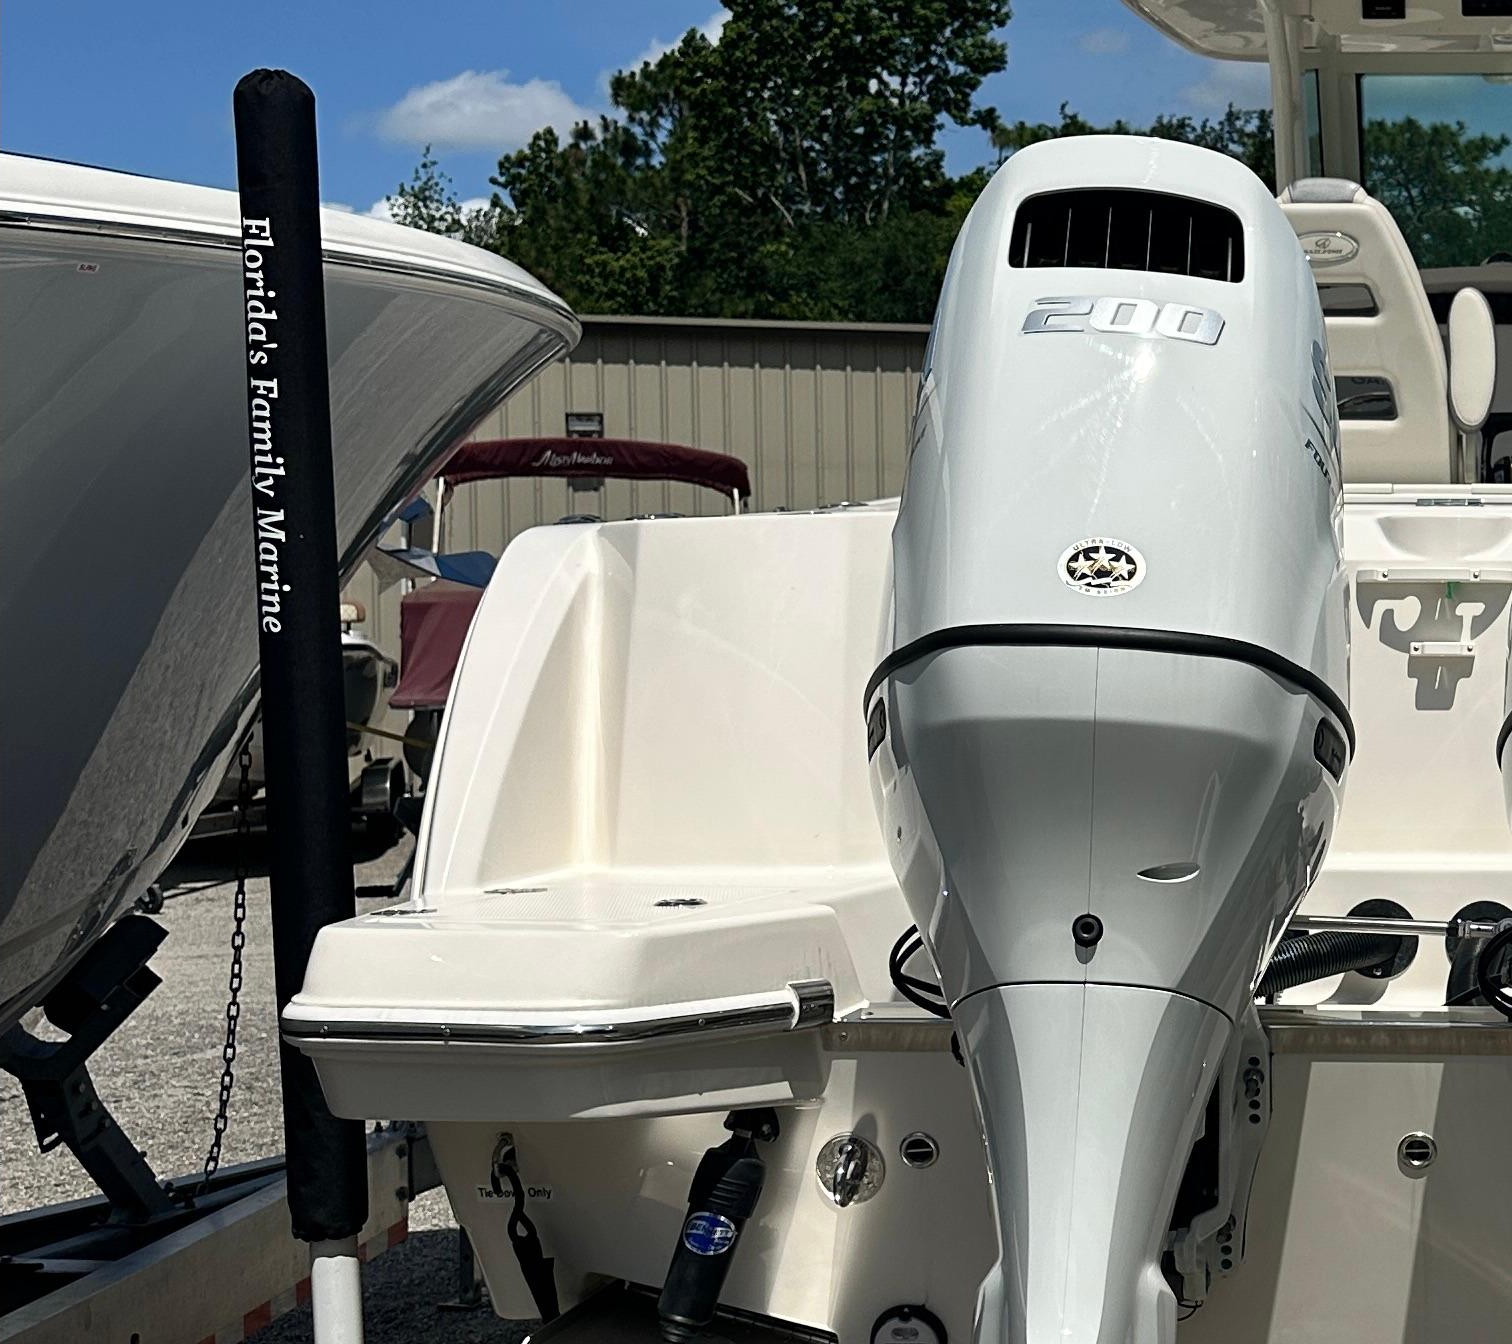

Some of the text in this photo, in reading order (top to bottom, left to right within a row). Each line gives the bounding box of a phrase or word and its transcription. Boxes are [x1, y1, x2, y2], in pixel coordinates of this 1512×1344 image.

[1021, 296, 1226, 346] 200
[242, 216, 291, 633] Florida's Family Marine
[528, 1187, 552, 1200] Only
